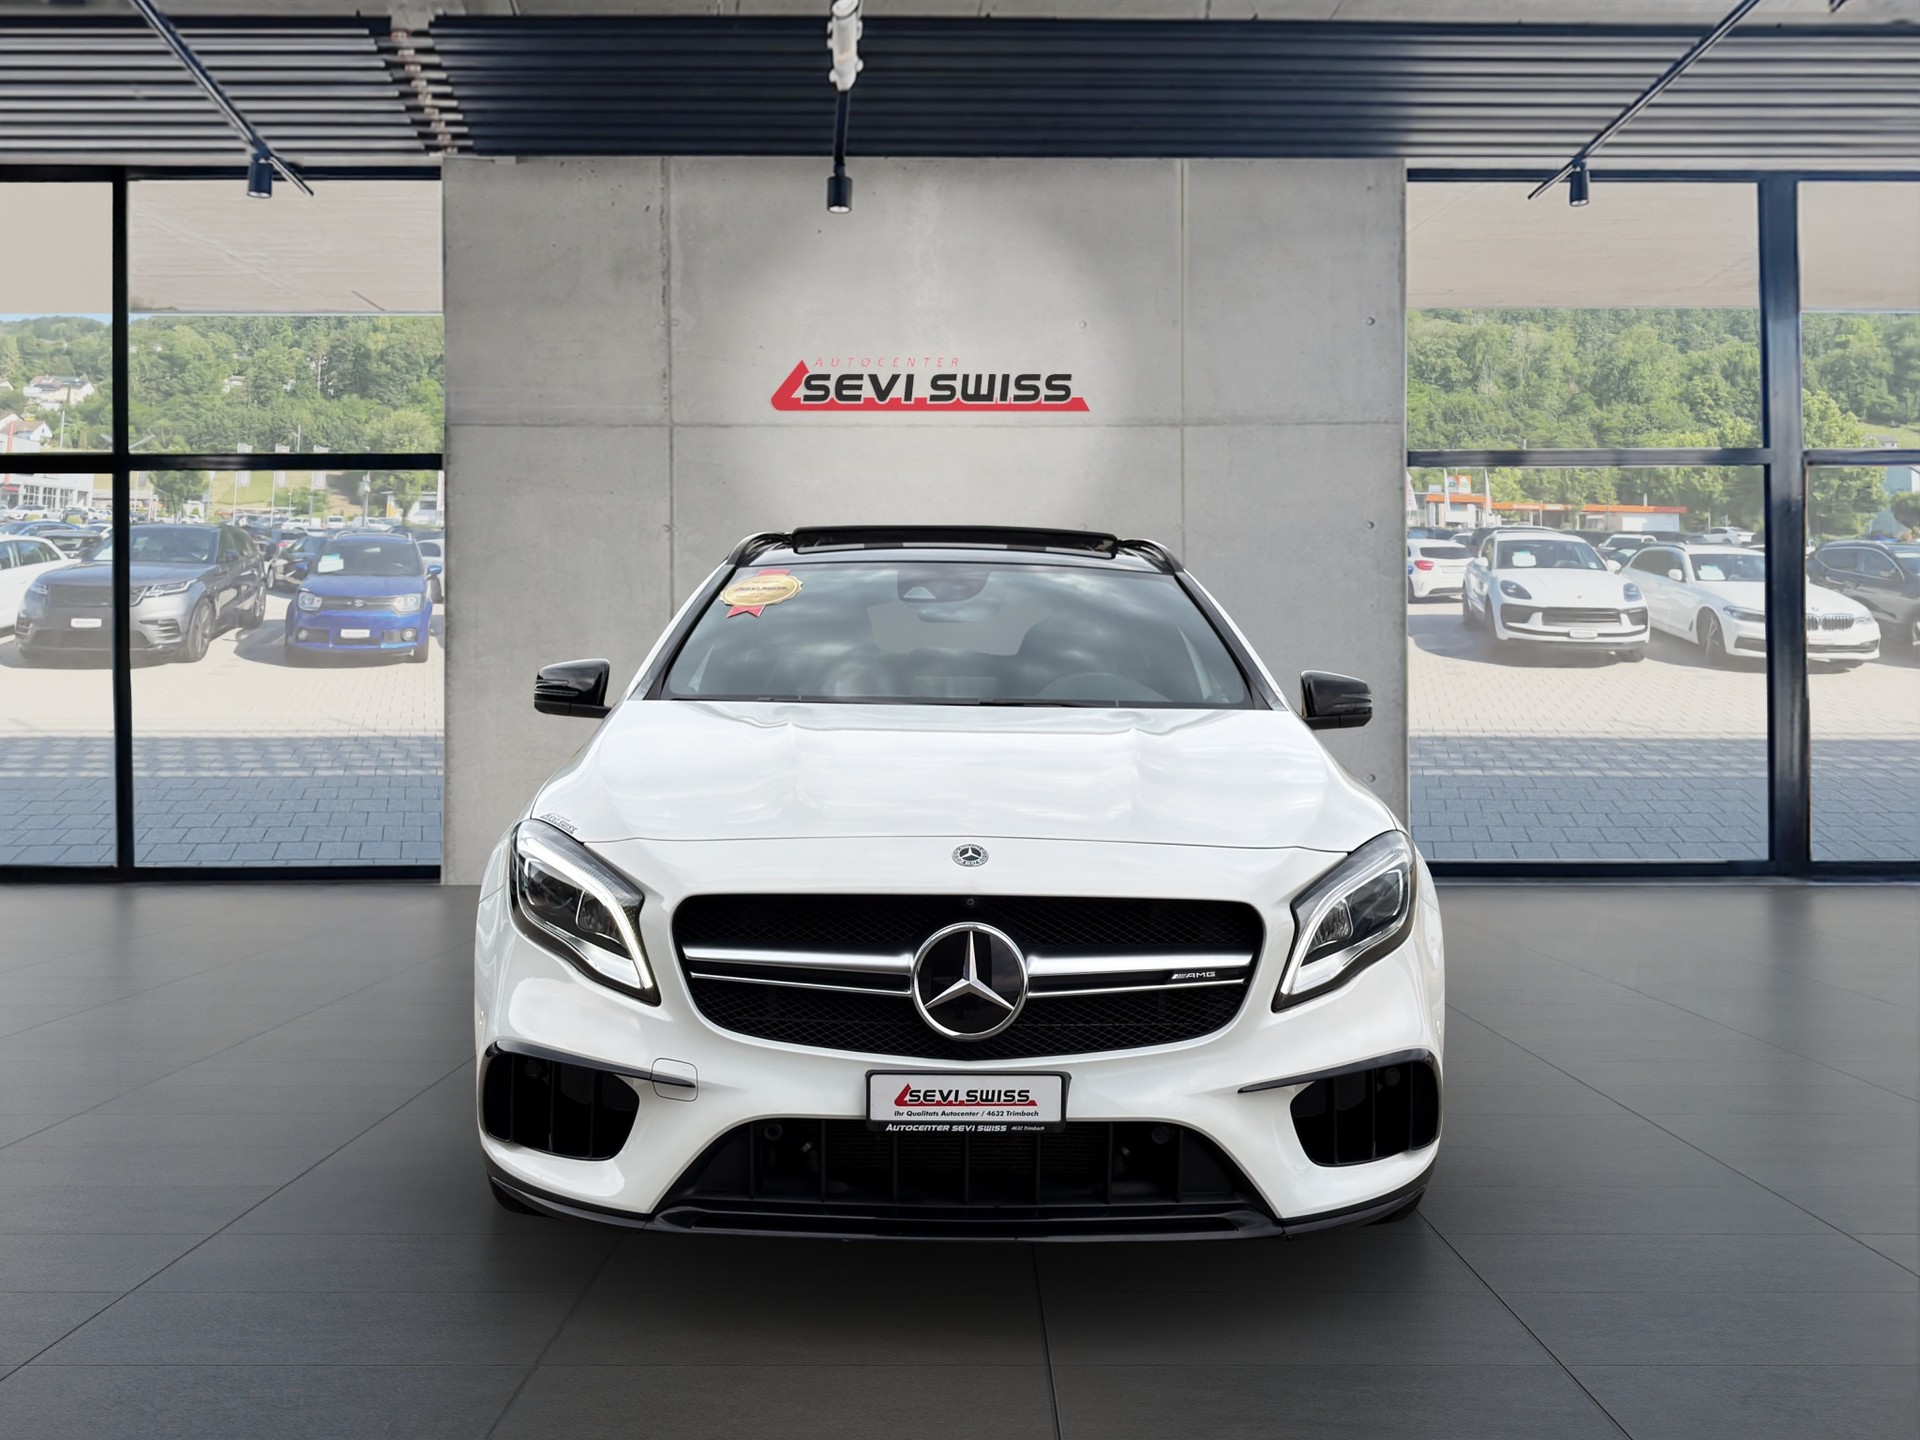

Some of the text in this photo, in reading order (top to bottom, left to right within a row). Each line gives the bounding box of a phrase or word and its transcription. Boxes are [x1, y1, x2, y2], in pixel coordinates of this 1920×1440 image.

[814, 357, 960, 368] AUTOCENTER
[802, 373, 1072, 402] SEVI SWISS
[1186, 971, 1216, 979] AMG
[908, 1089, 1031, 1103] SEVI SWISS
[885, 1123, 950, 1132] AUTOCENTER
[951, 1124, 976, 1132] SEVI
[976, 1124, 1008, 1132] SWISS
